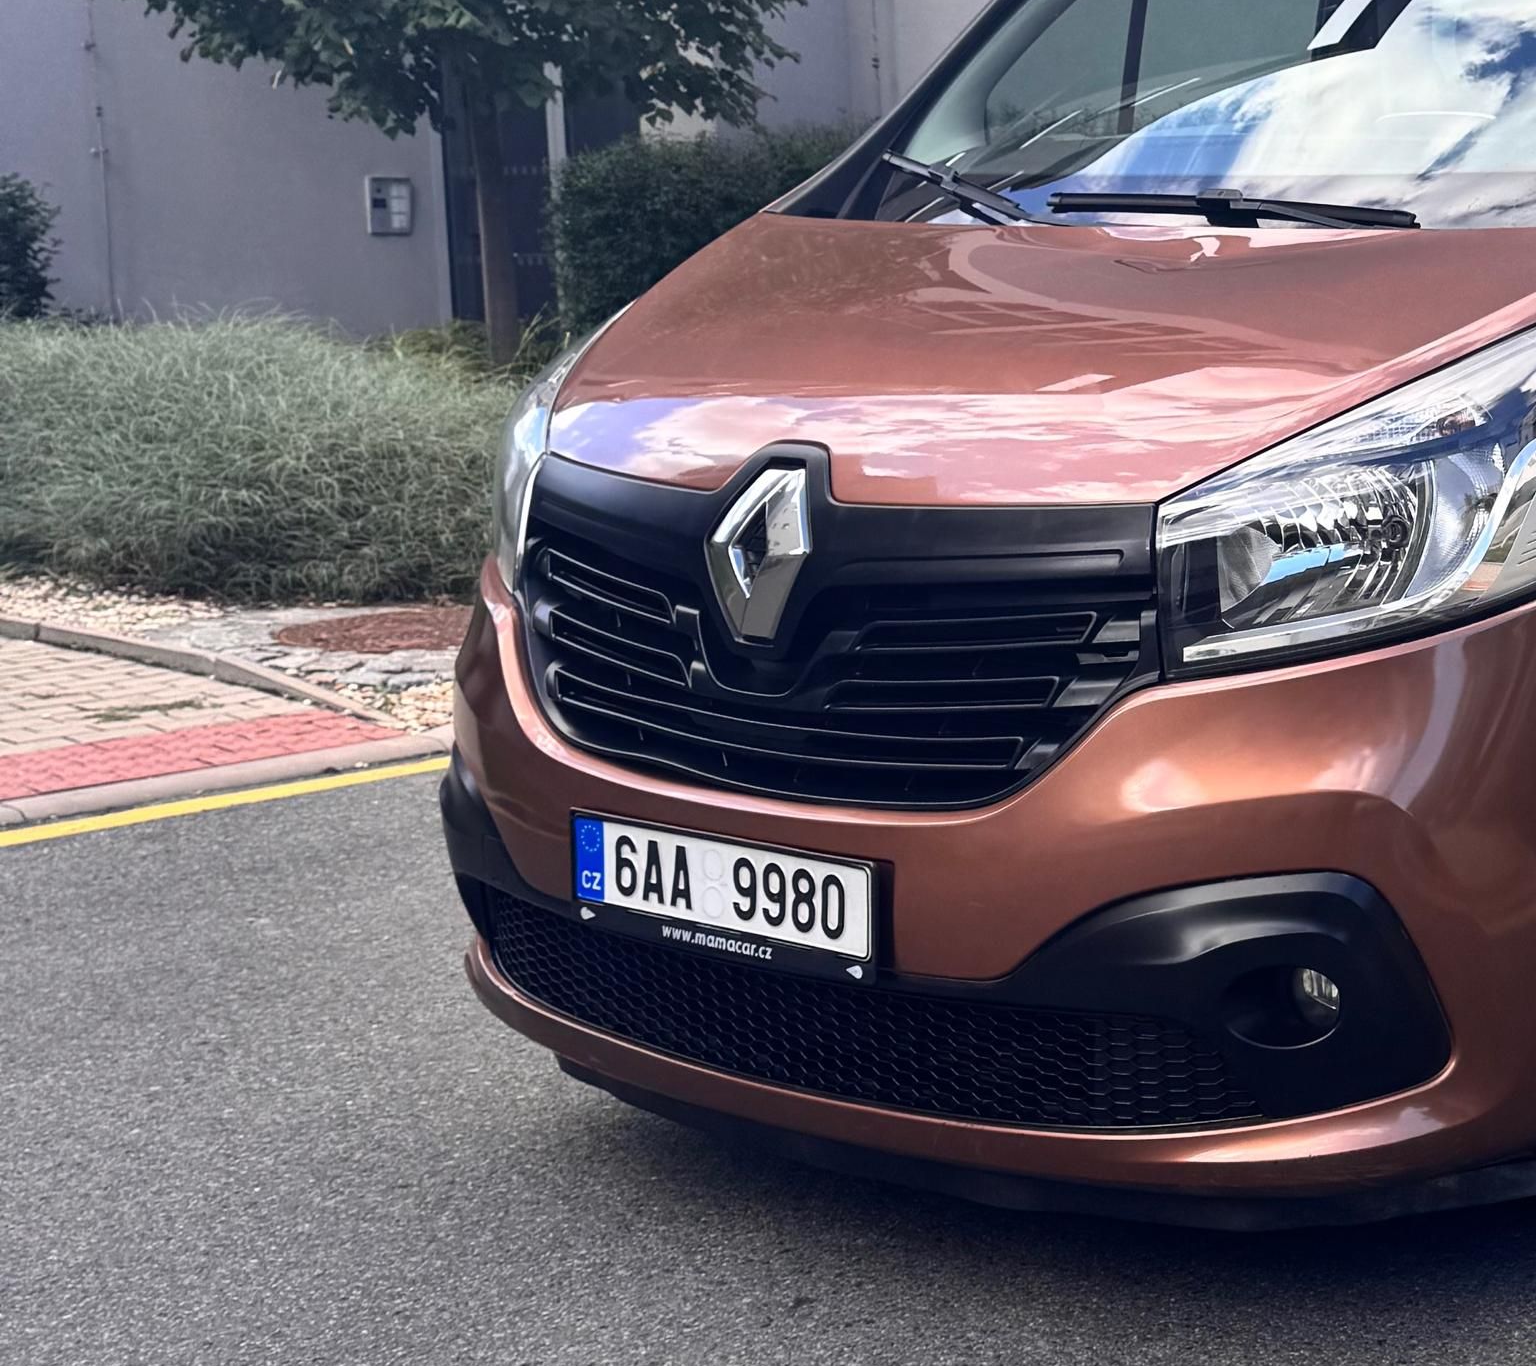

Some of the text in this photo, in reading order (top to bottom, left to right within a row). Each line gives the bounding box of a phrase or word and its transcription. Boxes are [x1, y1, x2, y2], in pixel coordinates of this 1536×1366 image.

[582, 870, 601, 890] CZ
[615, 835, 845, 939] 6AA 9980
[662, 924, 772, 960] www.mamacar.cz
